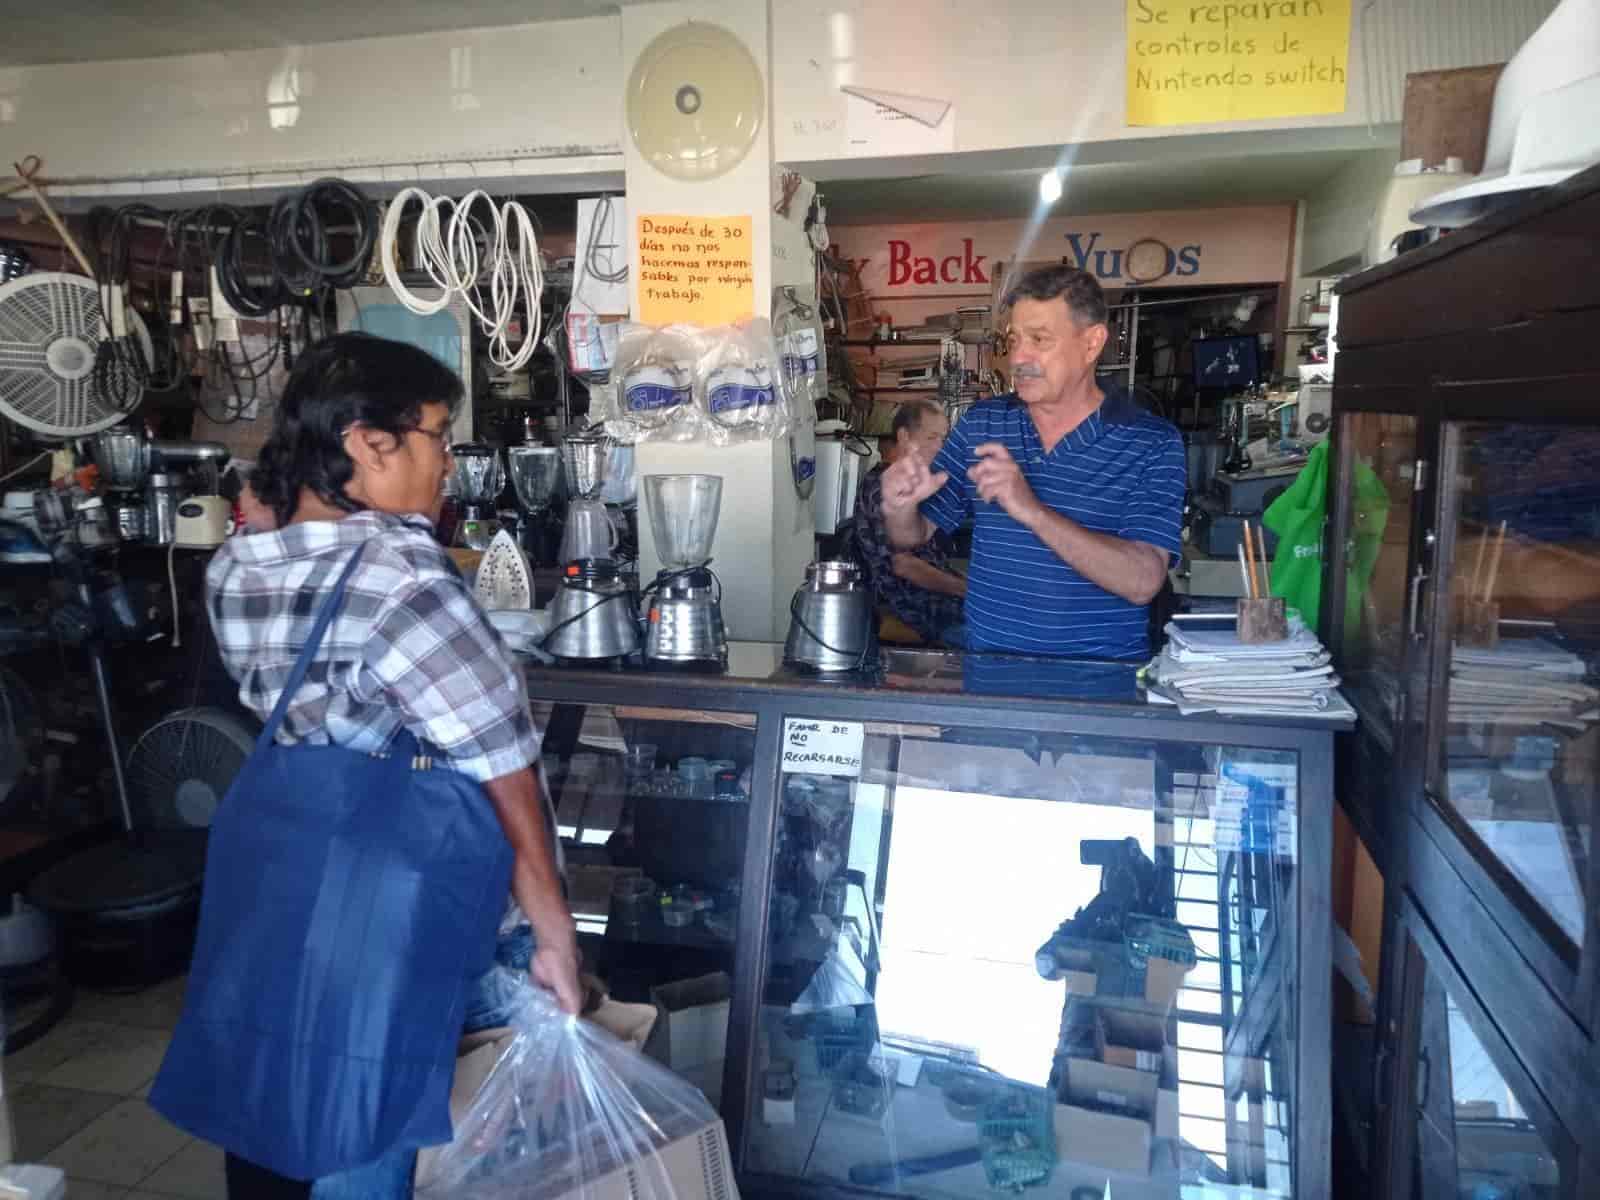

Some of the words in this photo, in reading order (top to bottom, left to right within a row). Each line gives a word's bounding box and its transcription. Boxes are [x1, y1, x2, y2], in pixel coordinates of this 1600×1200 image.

[1135, 0, 1168, 24] Se
[1189, 0, 1323, 28] reparan
[1135, 33, 1256, 56] controles
[1273, 31, 1301, 53] de
[1135, 65, 1253, 92] Nintendo
[1264, 57, 1345, 85] switch
[642, 218, 695, 235] Después
[699, 223, 715, 238] de
[723, 226, 743, 238] 30
[639, 237, 665, 251] días
[671, 243, 690, 252] no
[696, 243, 720, 254] nos
[641, 256, 699, 268] hacemos
[887, 238, 989, 286] Back
[688, 274, 711, 285] por
[789, 733, 808, 742] NO
[832, 725, 849, 735] DE
